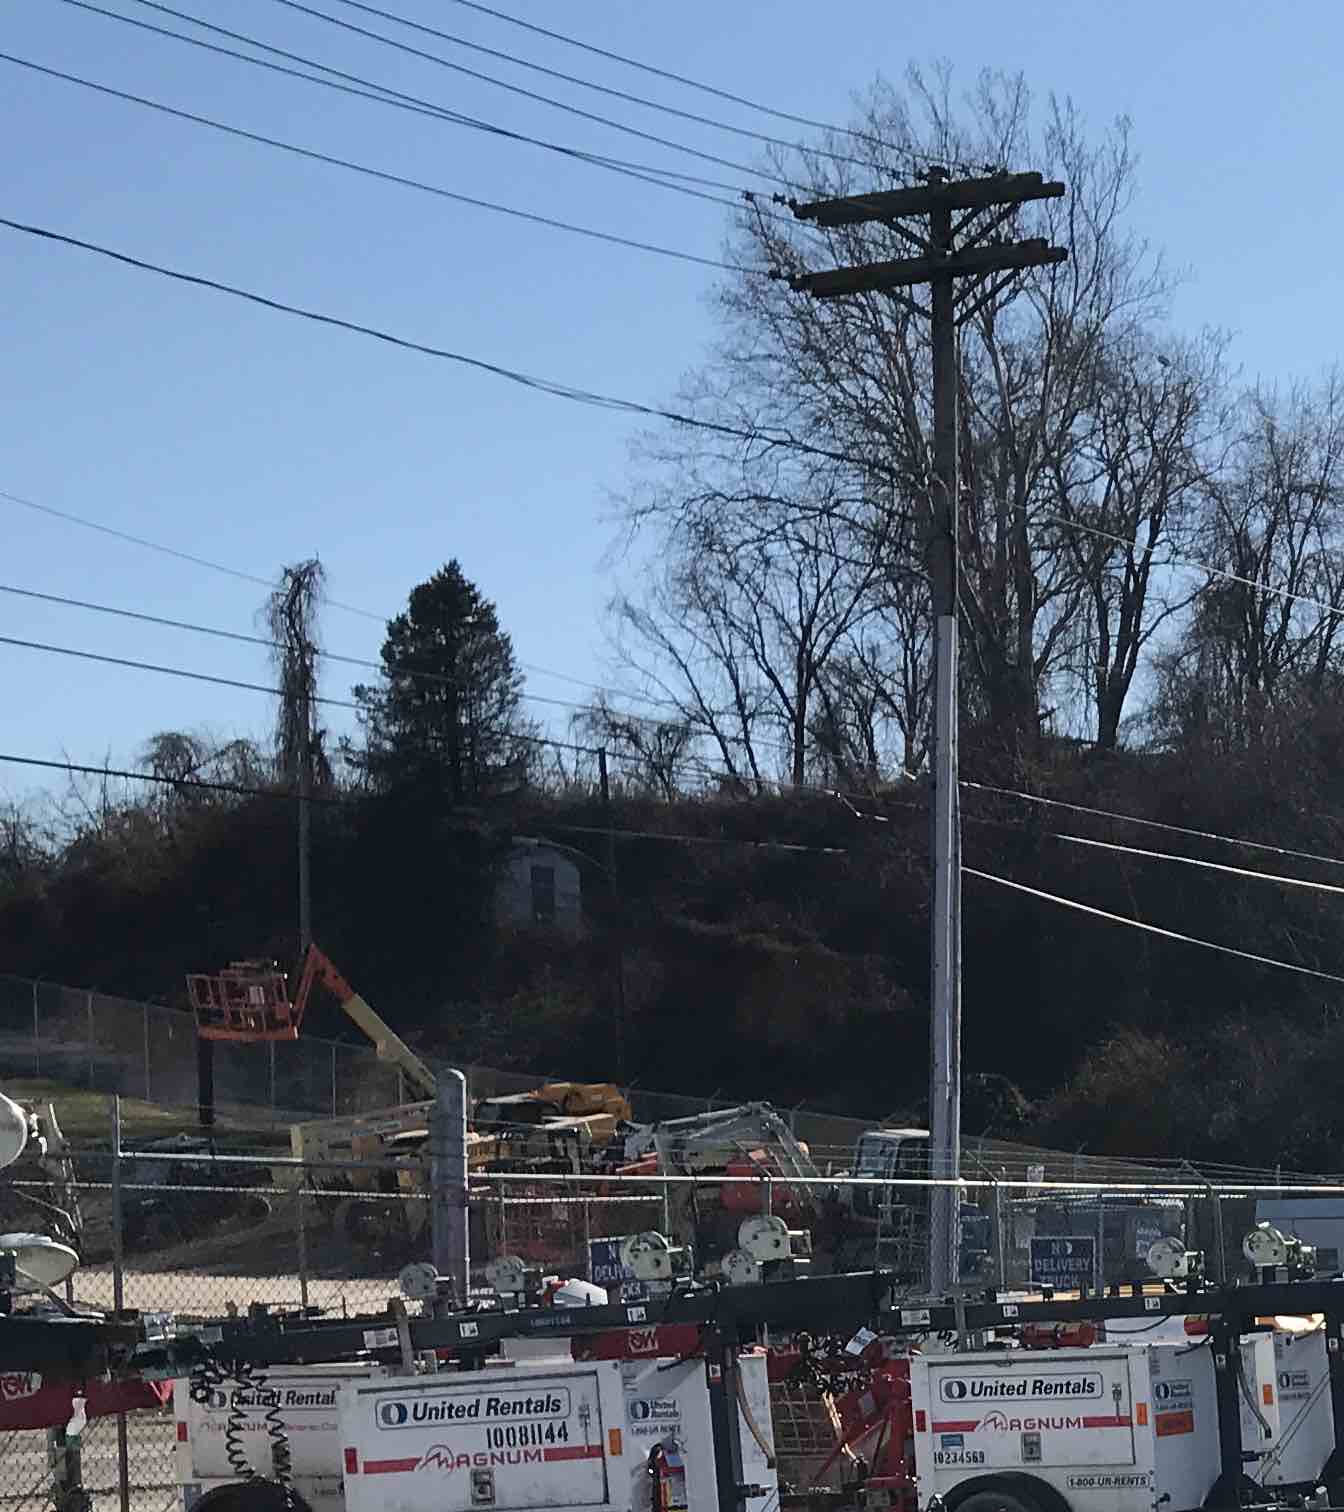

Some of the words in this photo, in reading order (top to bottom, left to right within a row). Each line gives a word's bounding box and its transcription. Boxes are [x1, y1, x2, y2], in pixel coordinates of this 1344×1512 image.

[1034, 1258, 1091, 1271] DELIVERY
[970, 1381, 1026, 1397] United
[1031, 1378, 1096, 1395] Rentals
[412, 1401, 480, 1421] United
[485, 1395, 562, 1417] Rentals
[978, 1410, 1082, 1432] MAGNUM
[486, 1421, 569, 1449] 10081144
[420, 1443, 543, 1474] MAGNUM
